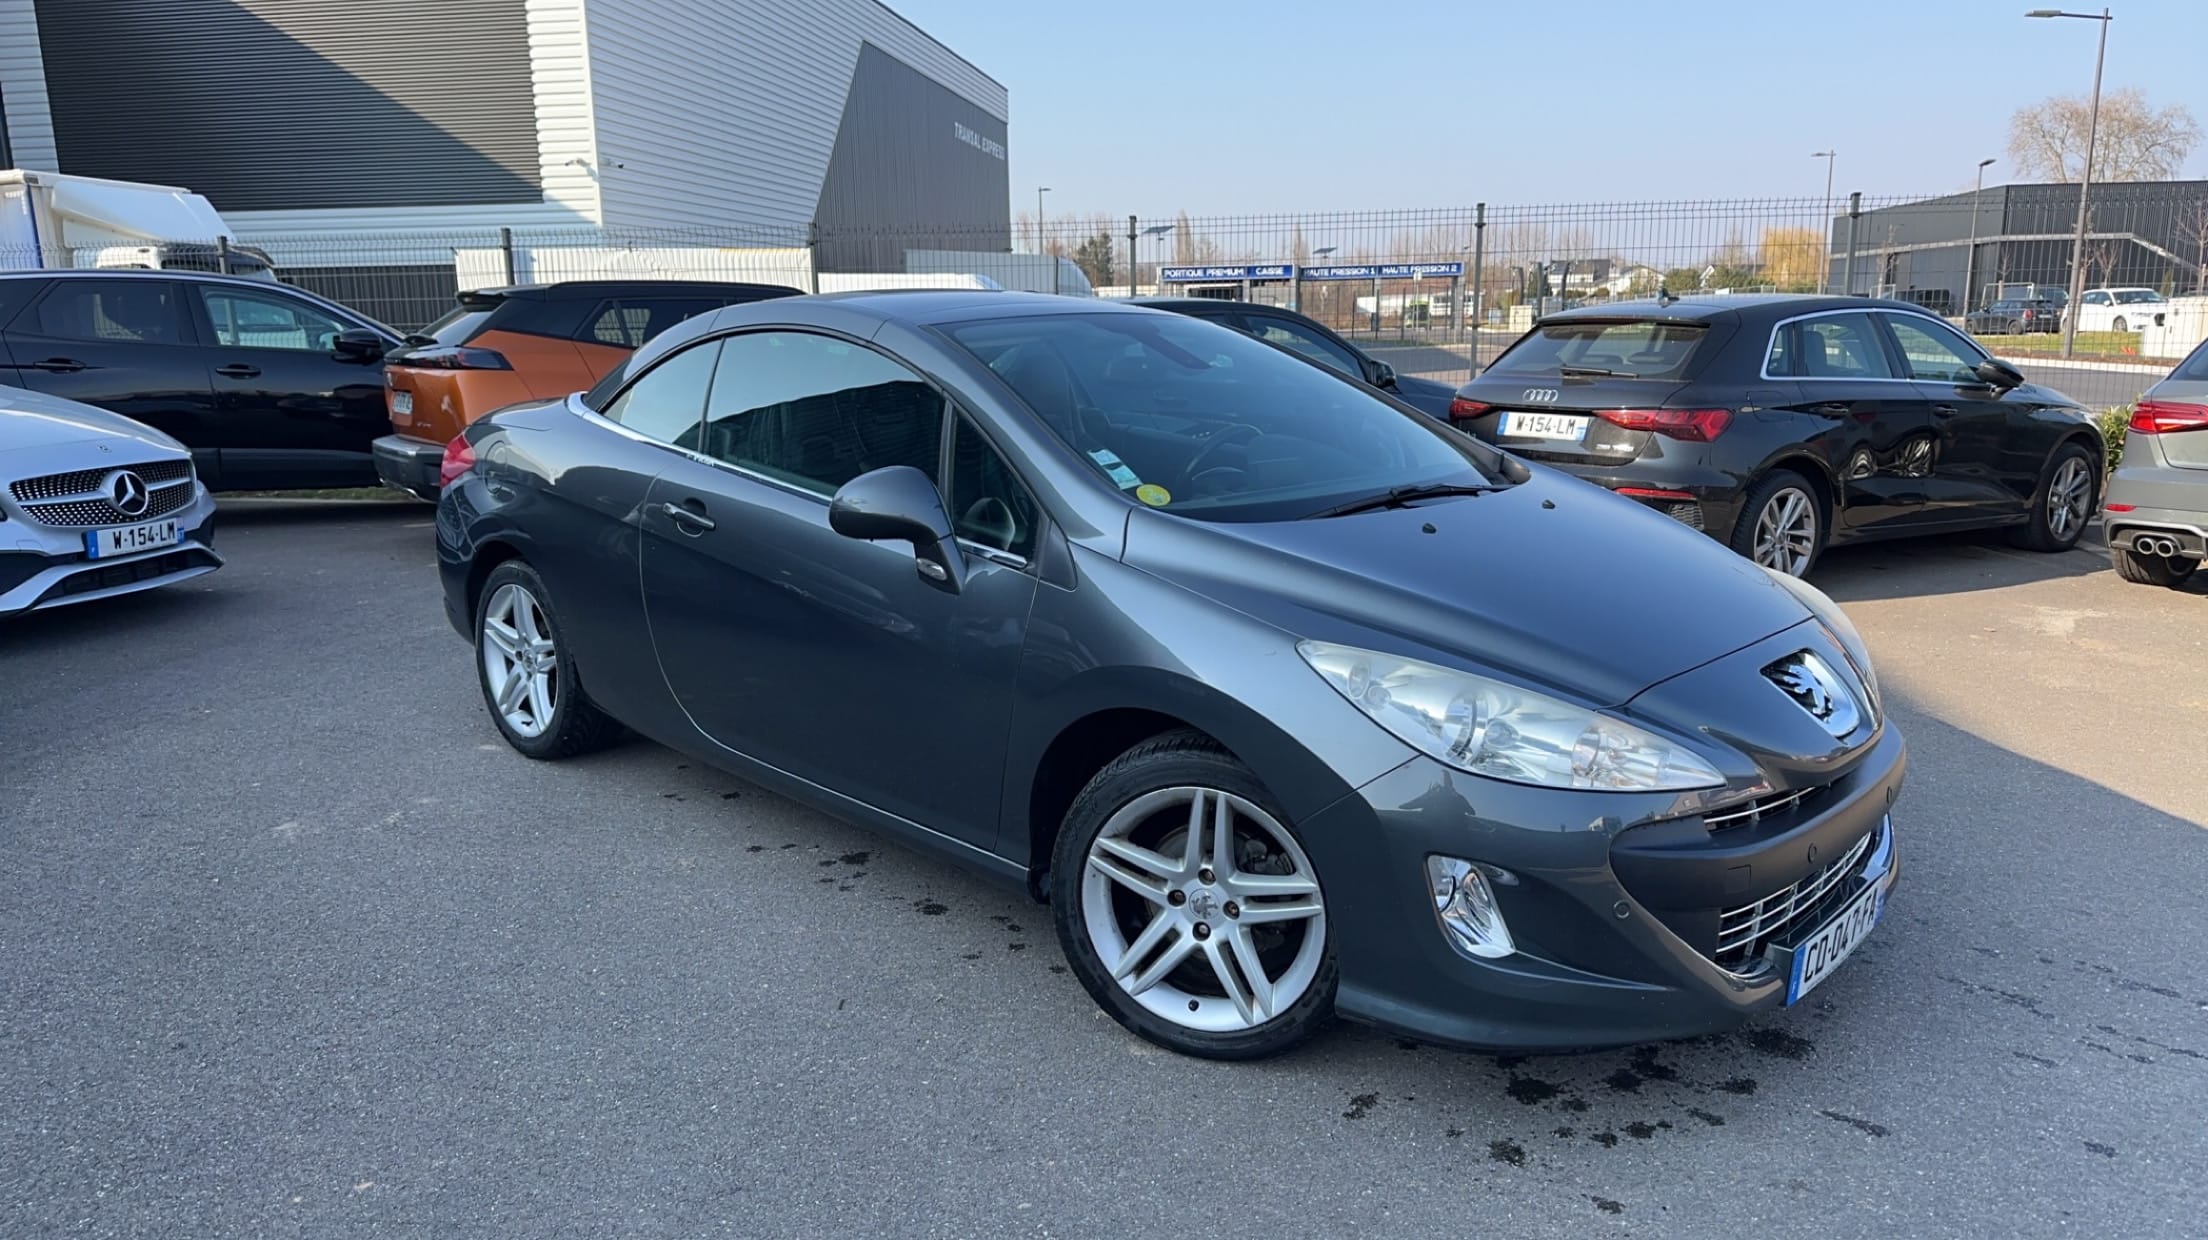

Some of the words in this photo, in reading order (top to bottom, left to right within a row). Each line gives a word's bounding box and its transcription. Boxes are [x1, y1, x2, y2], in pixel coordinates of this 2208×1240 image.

[982, 137, 1005, 160] EXPRESS
[1164, 269, 1204, 278] PORTIQUE
[1206, 268, 1244, 277] PREMIUM
[1255, 266, 1284, 276] CAISSE
[1304, 267, 1328, 276] HAUTE
[1331, 266, 1369, 275] PRESSION
[1383, 266, 1408, 274] HAUTE
[1410, 265, 1449, 273] PRESSION
